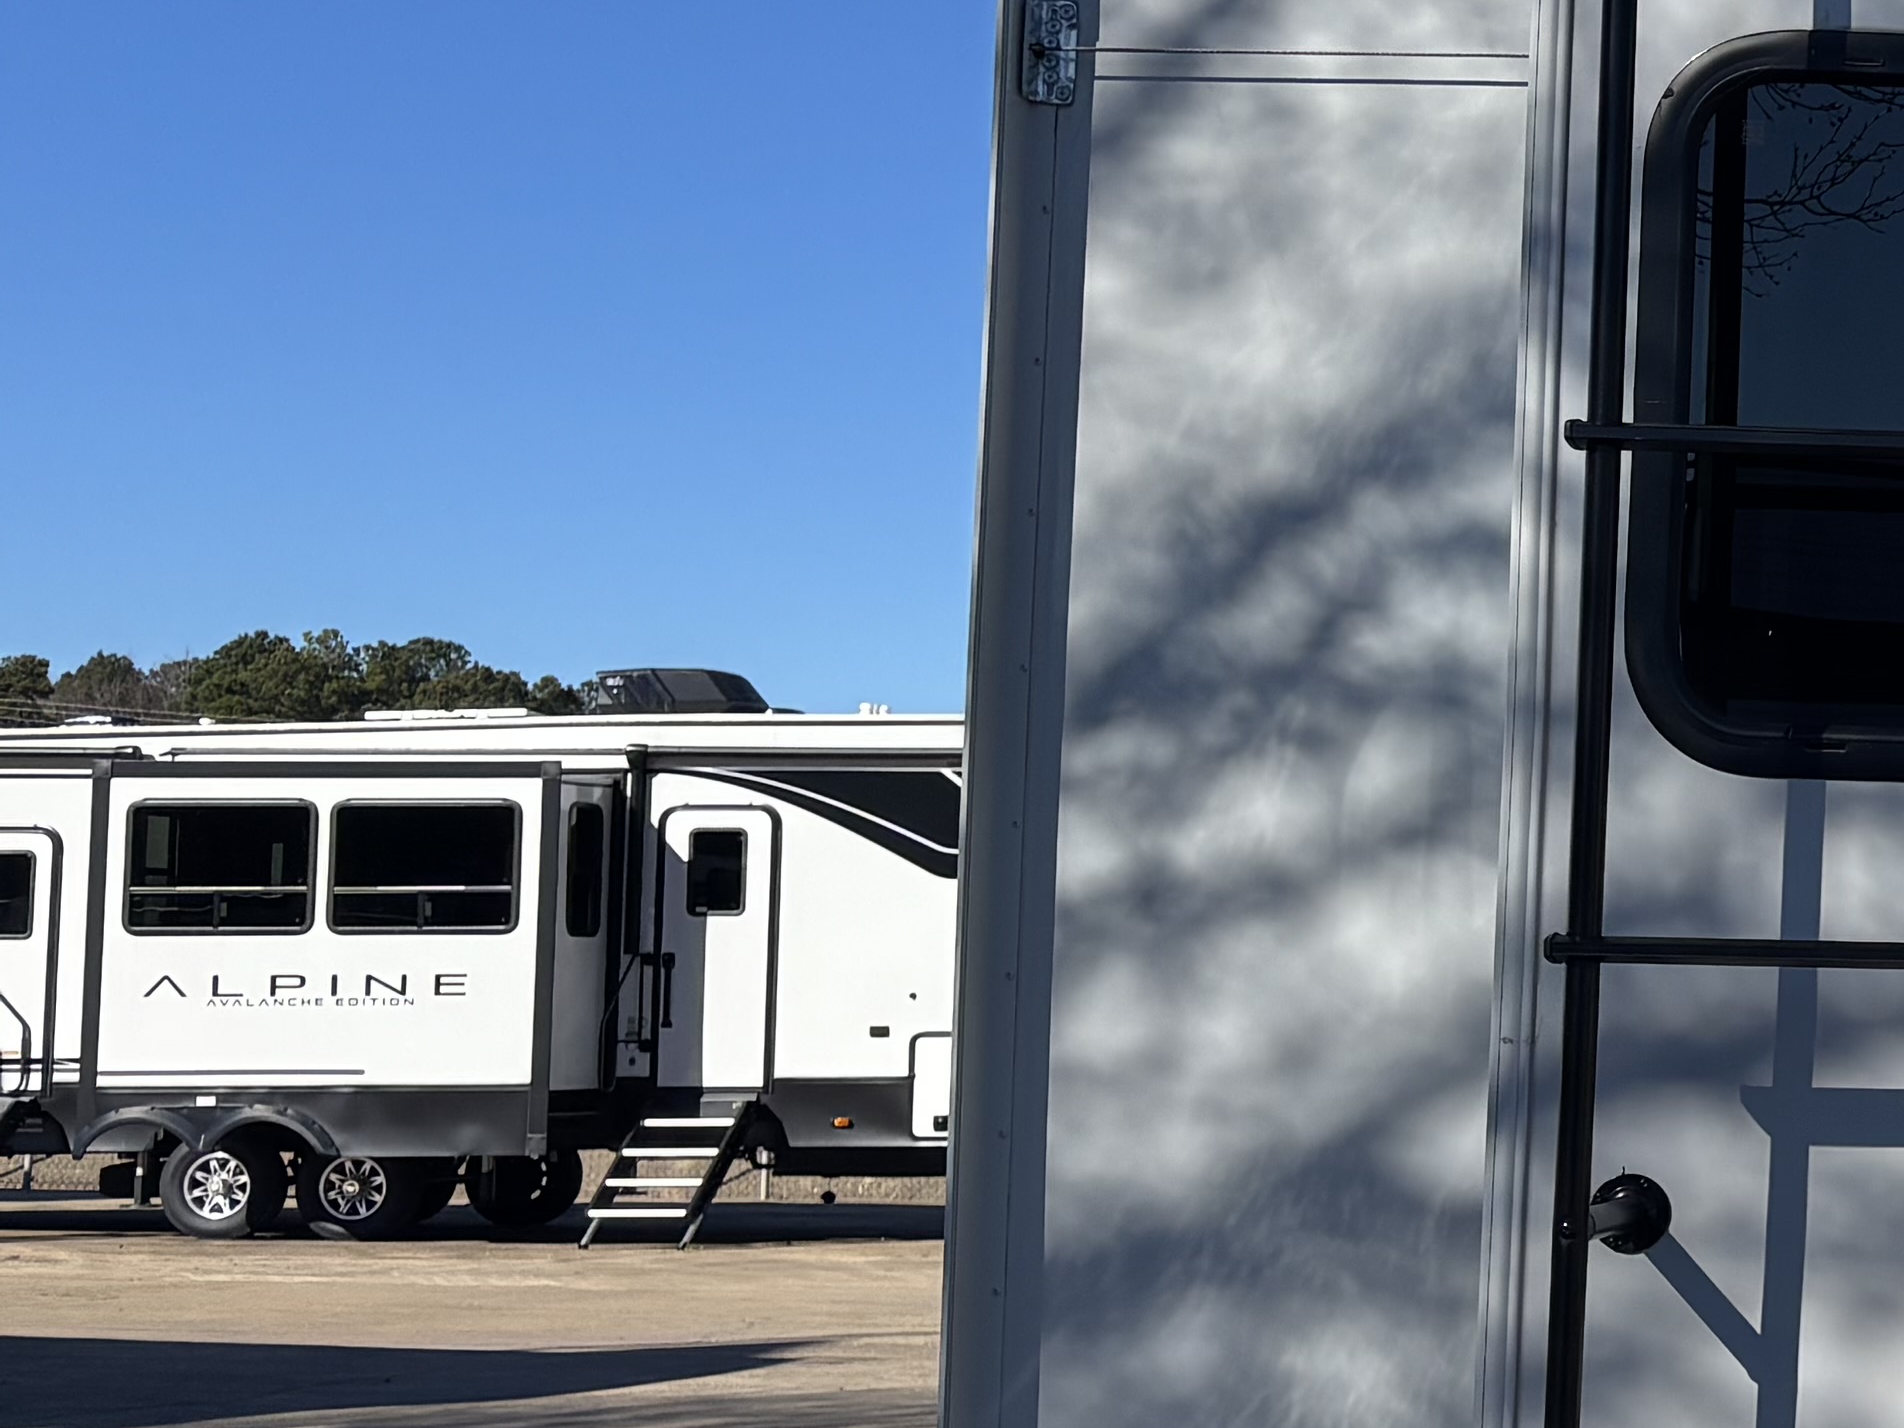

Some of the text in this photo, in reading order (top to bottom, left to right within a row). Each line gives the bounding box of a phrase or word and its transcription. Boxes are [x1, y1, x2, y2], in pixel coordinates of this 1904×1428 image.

[143, 973, 468, 997] ALPINE
[207, 997, 415, 1007] AVALANCHE EDITION
